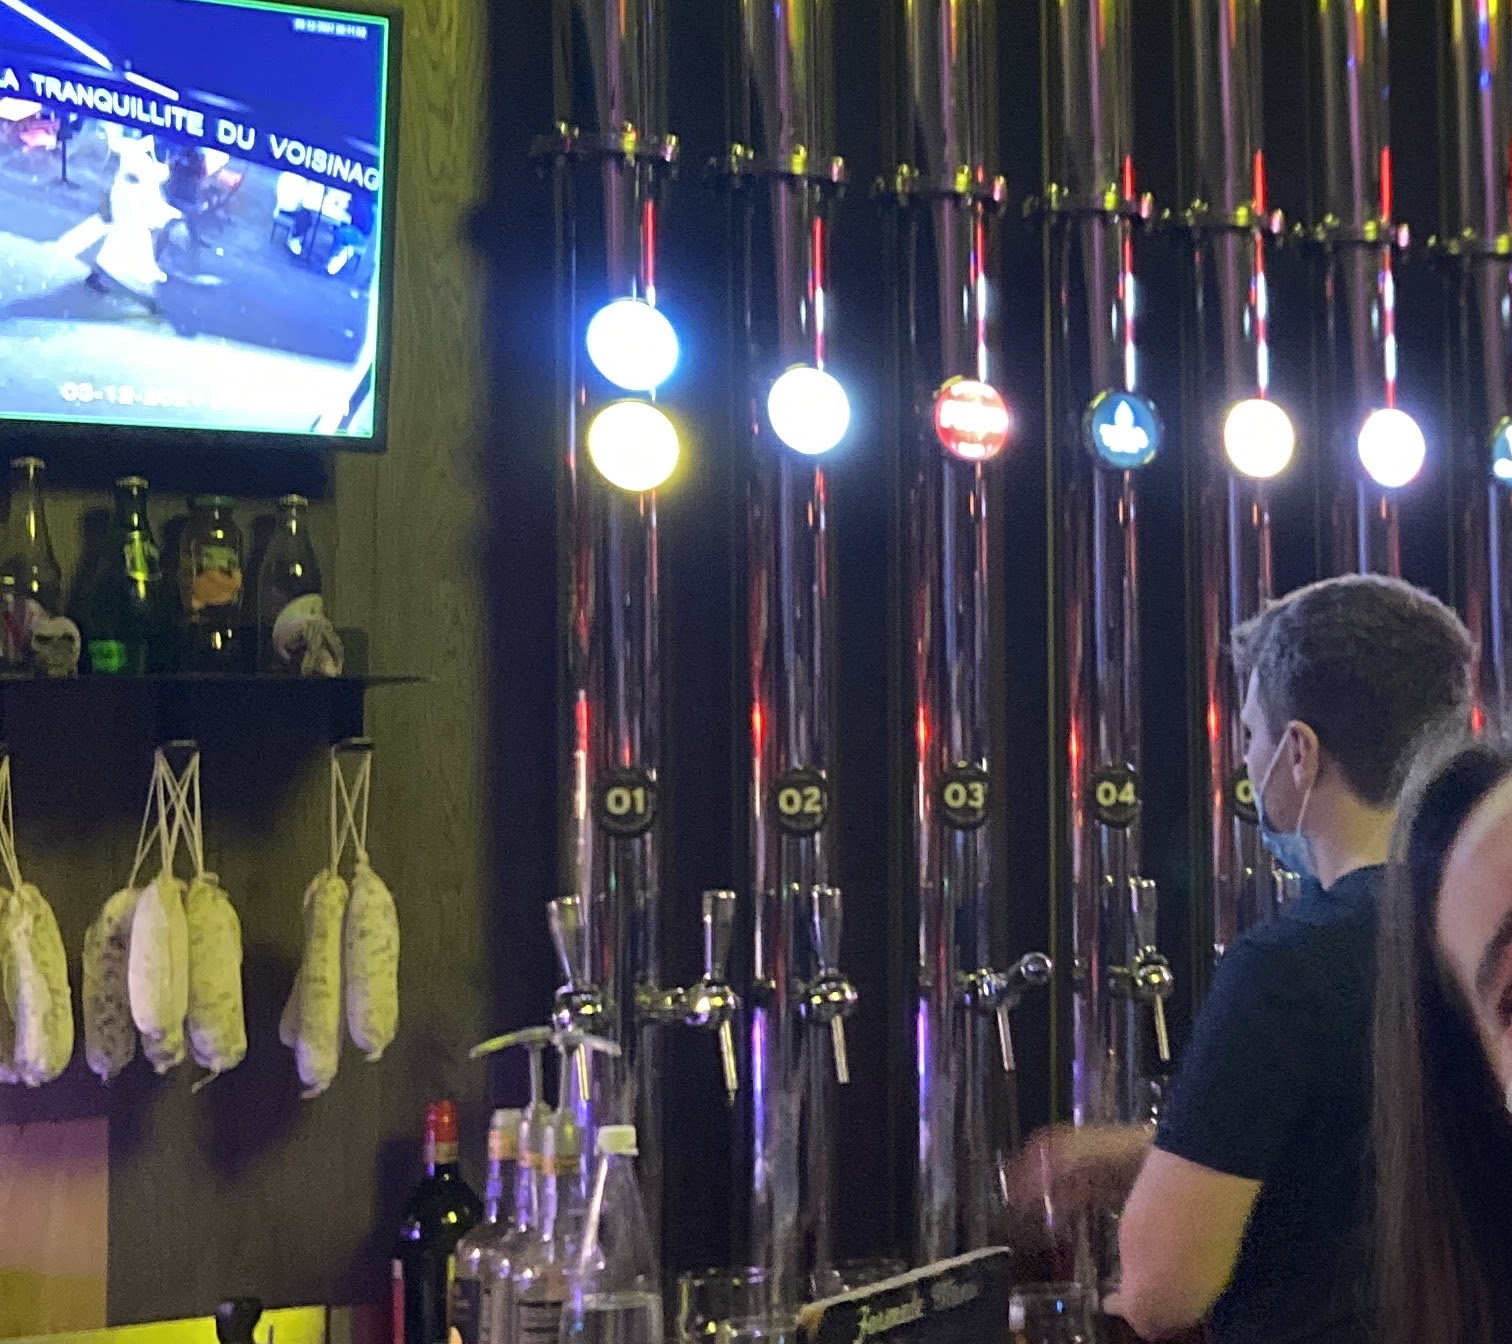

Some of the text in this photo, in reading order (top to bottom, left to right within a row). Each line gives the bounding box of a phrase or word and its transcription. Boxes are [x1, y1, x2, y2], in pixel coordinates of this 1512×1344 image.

[29, 72, 205, 137] TRANQUILLITE
[216, 118, 256, 150] DU
[606, 786, 646, 816] 01
[778, 786, 822, 816] 02
[943, 781, 986, 809] 03
[1095, 780, 1137, 807] 04
